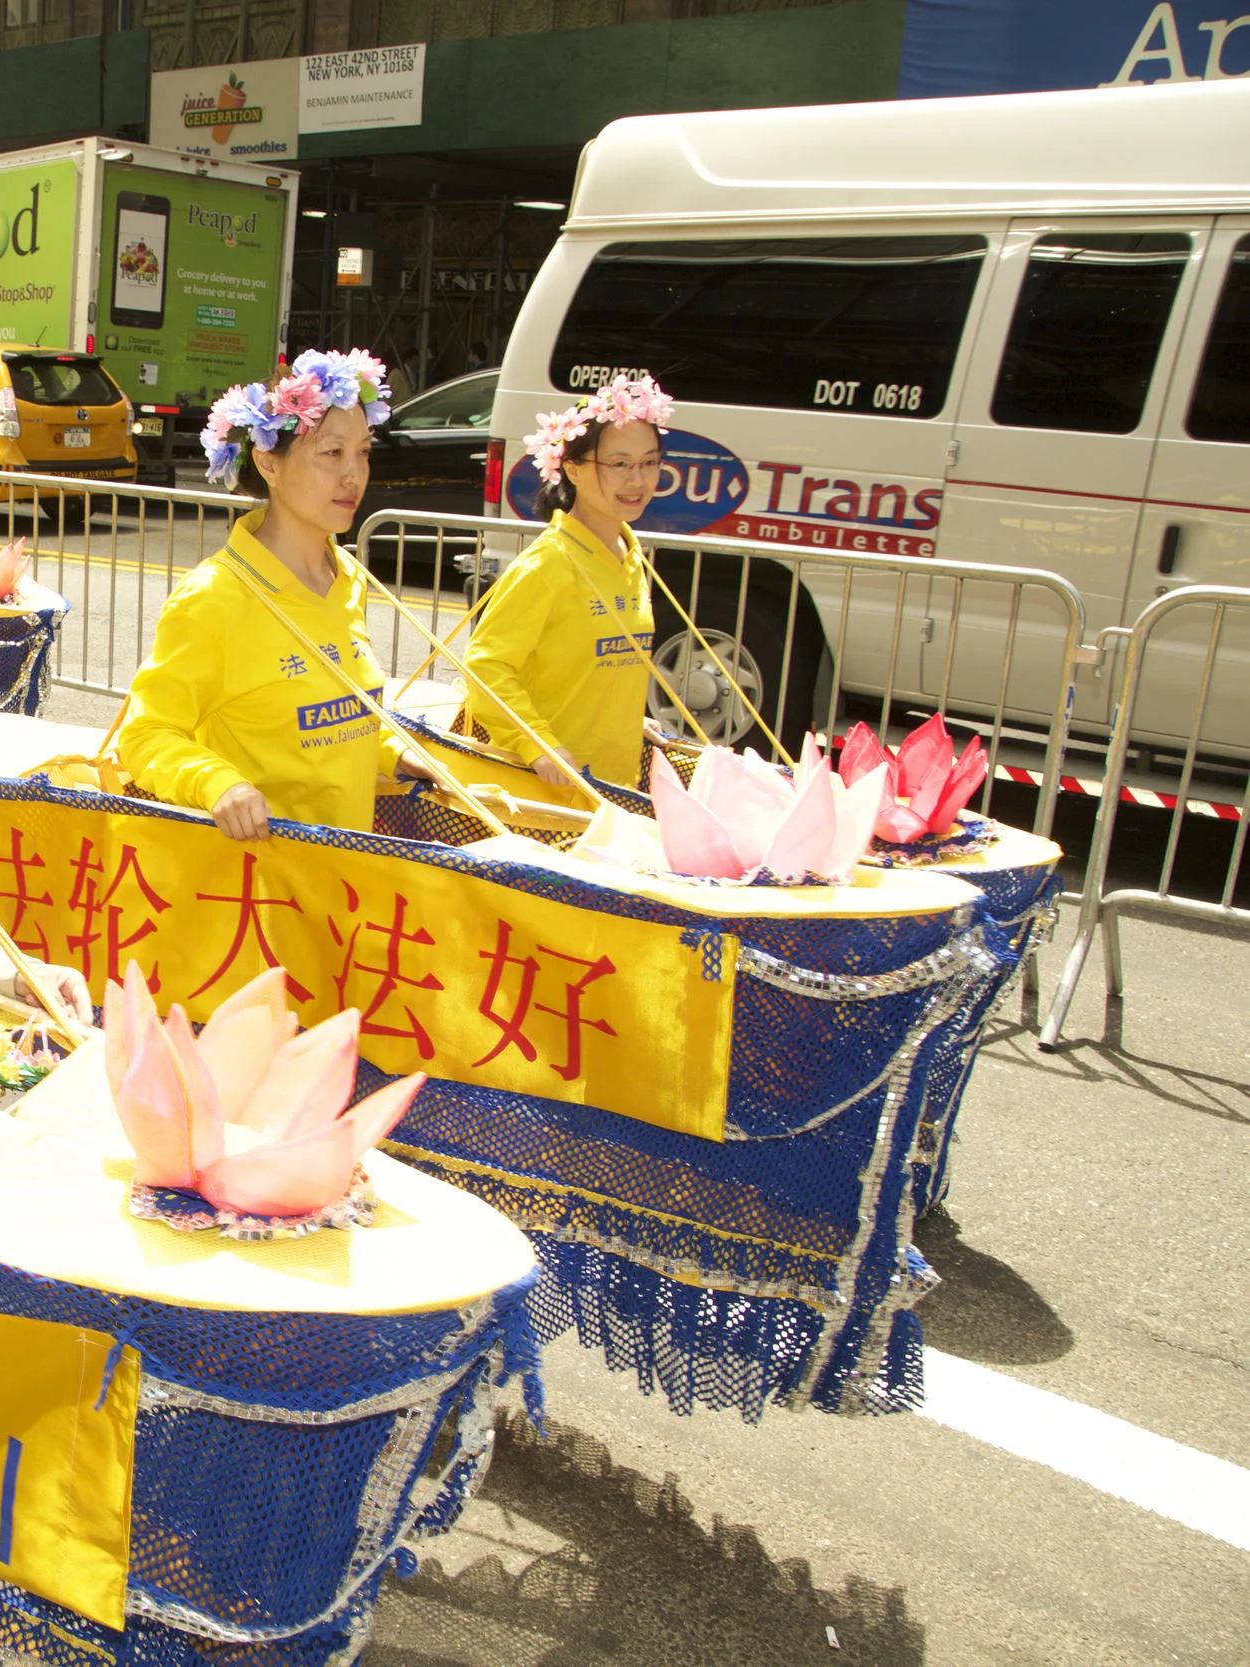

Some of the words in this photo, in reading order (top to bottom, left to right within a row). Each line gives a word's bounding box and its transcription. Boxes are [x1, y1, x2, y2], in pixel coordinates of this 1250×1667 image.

[306, 58, 323, 70] 122
[325, 54, 349, 67] EAST
[351, 51, 379, 64] 42ND
[381, 47, 419, 61] STREET
[308, 68, 332, 81] NEW
[334, 65, 364, 79] YORK,
[366, 63, 381, 75] NY
[383, 60, 414, 74] 10168
[180, 92, 216, 115] juice
[306, 95, 349, 108] BENJAMIN
[350, 89, 414, 104] MAINTENANCE
[185, 108, 261, 126] GENERATION
[230, 140, 287, 155] smoothies
[187, 203, 257, 235] Peapod
[176, 267, 210, 282] Grocery
[210, 271, 242, 288] delivery
[242, 277, 251, 286] to
[251, 280, 267, 288] you
[183, 285, 192, 294] at
[193, 284, 216, 297] home
[216, 290, 226, 298] or
[227, 290, 236, 298] at
[813, 379, 860, 406] DOT
[873, 384, 923, 411] 0618
[757, 461, 942, 530] Trans
[736, 519, 934, 558] ambulette
[304, 699, 362, 727] FALUN
